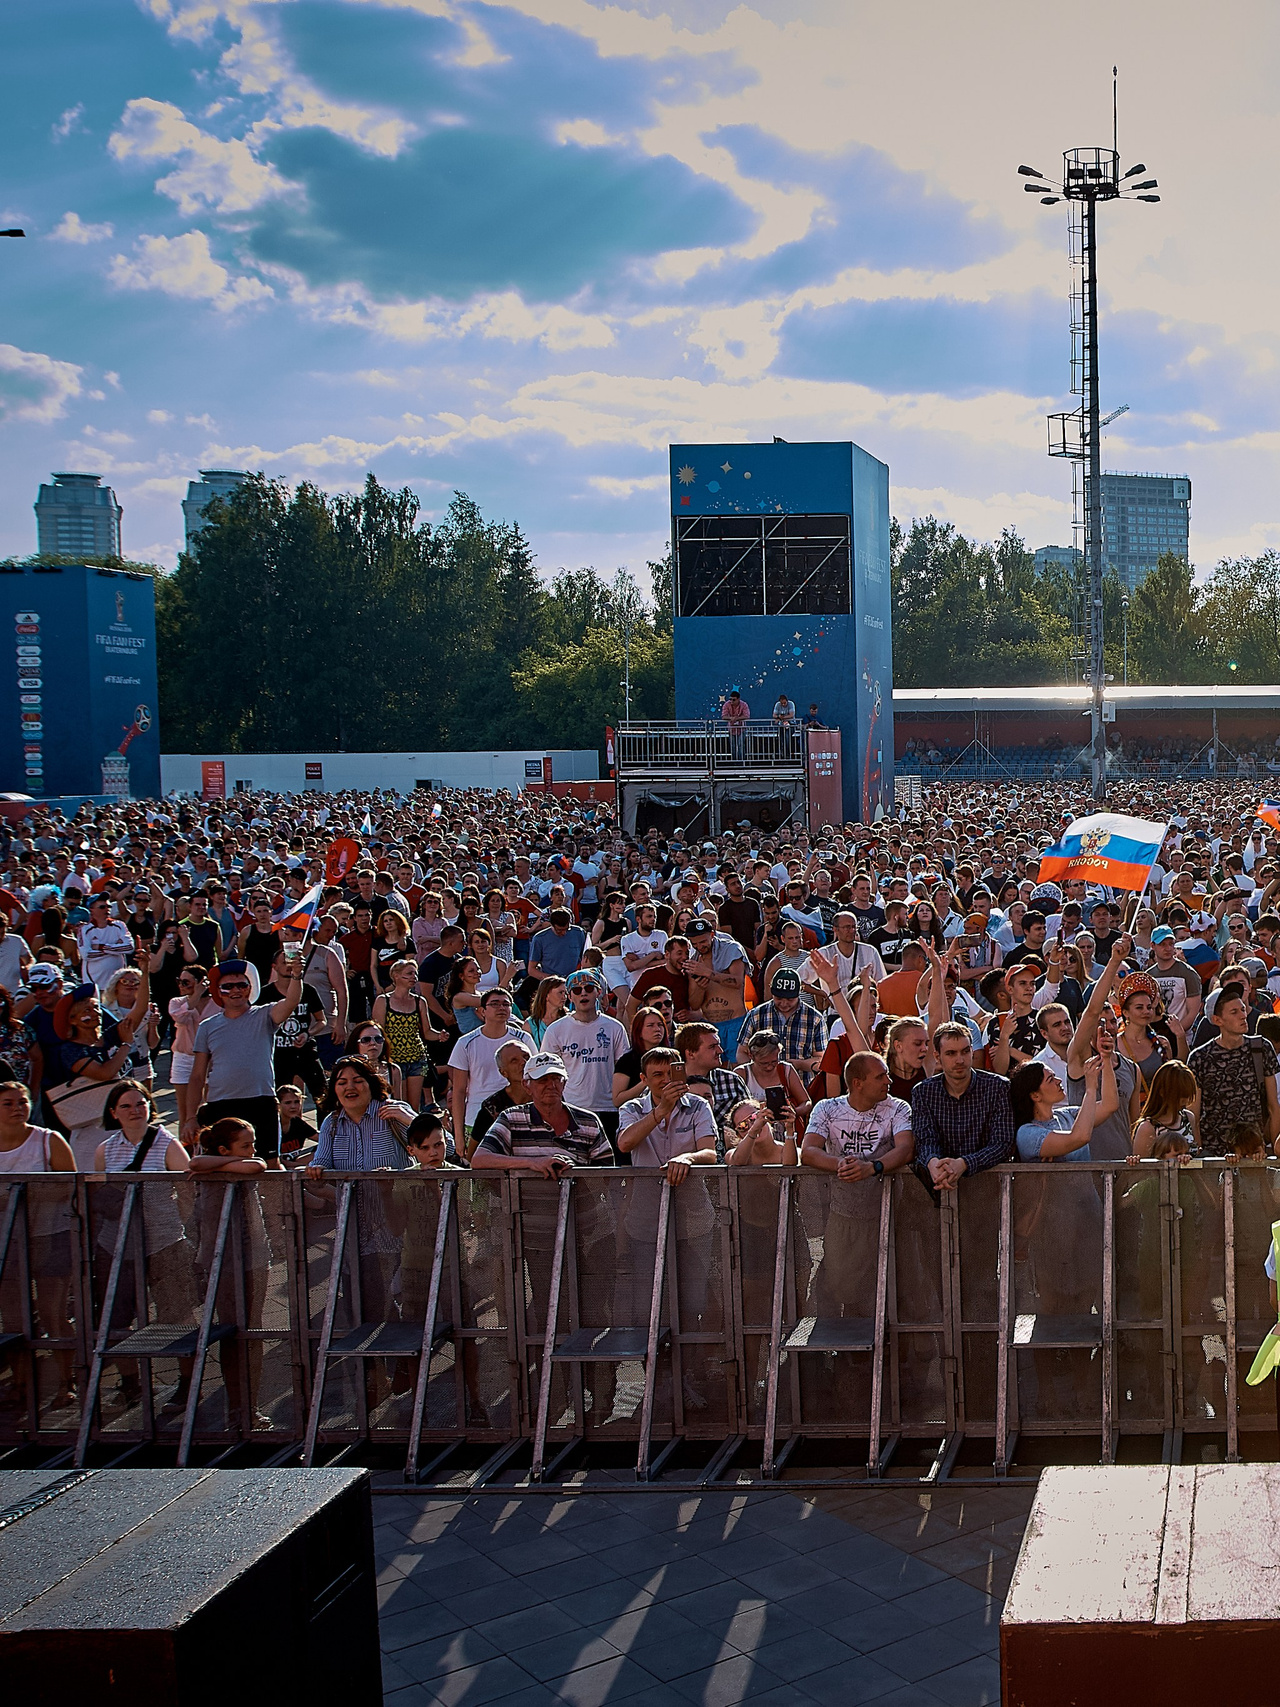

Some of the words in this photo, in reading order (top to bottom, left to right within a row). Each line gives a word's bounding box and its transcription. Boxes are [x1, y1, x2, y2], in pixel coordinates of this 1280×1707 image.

[96, 634, 112, 645] FIFA
[112, 636, 128, 647] FAN
[128, 637, 146, 648] FEST
[776, 979, 796, 990] SPB
[582, 1055, 609, 1064] Попов!
[841, 1130, 878, 1140] NIKE
[843, 1142, 874, 1152] AIR
